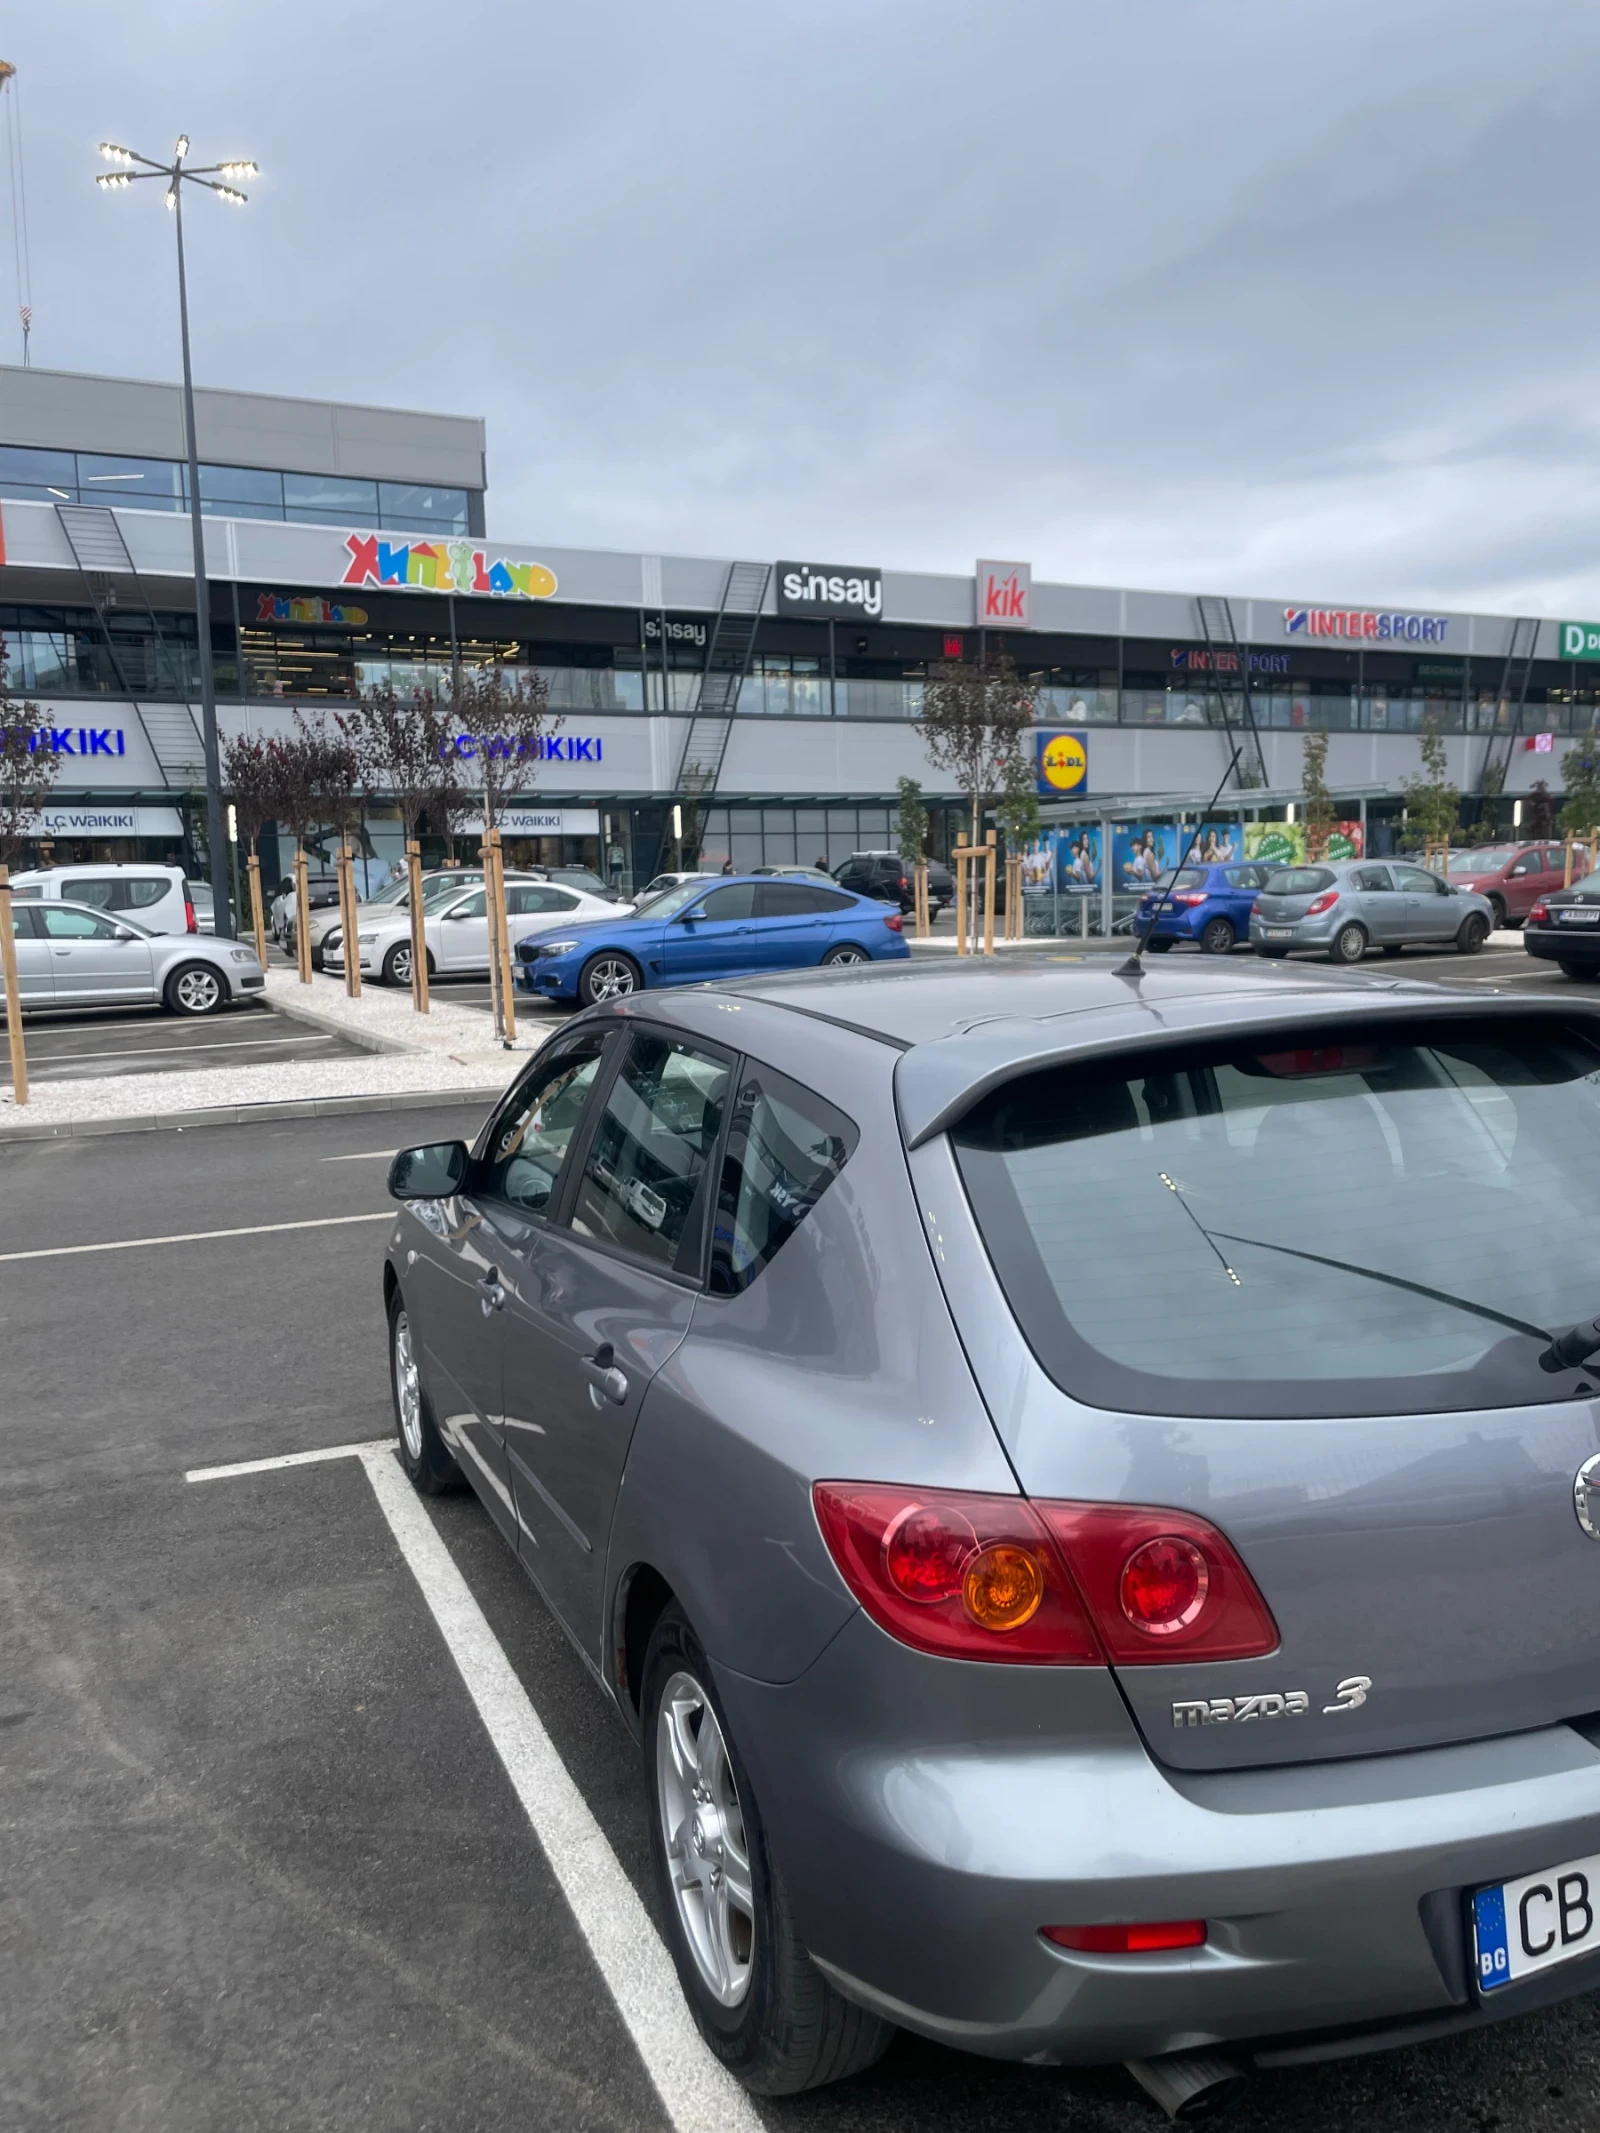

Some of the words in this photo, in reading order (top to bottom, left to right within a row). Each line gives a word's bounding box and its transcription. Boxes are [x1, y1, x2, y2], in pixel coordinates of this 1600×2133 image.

[783, 567, 882, 615] sinsay
[1307, 609, 1448, 642] INTERSPORT
[1188, 650, 1290, 673] INTERPORT
[1322, 1676, 1373, 1713] 3
[1519, 1871, 1594, 1957] CB
[1480, 1947, 1507, 1976] BG
